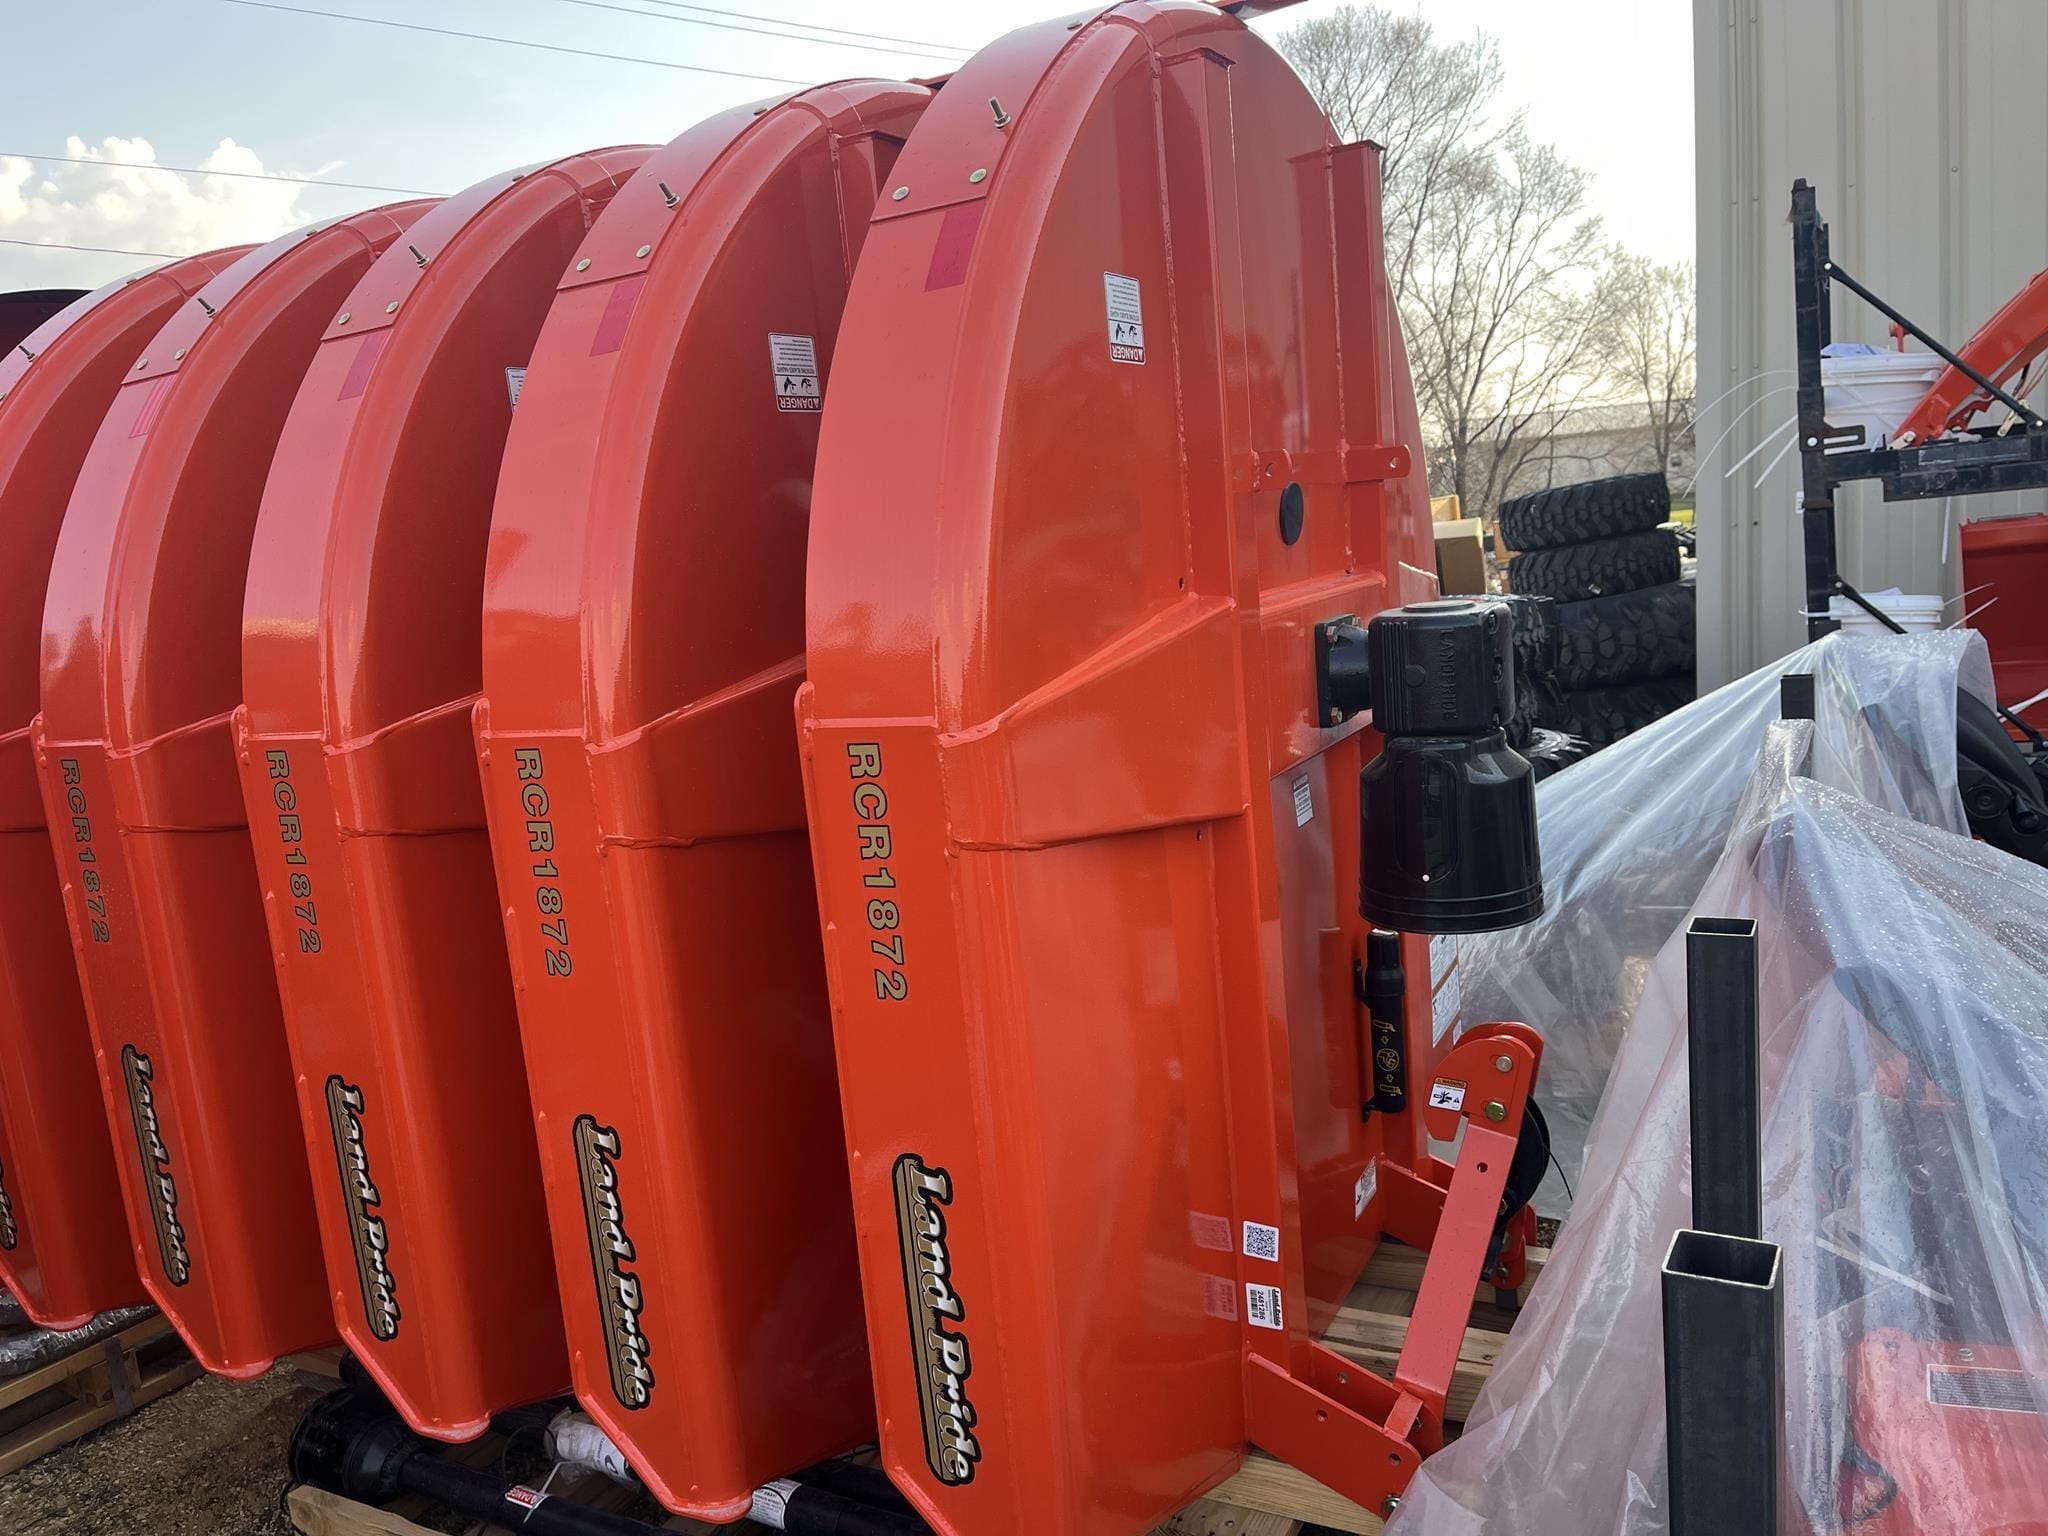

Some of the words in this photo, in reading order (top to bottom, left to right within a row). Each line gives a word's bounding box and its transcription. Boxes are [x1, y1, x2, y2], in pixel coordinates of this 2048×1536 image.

[779, 397, 813, 409] DANGER
[1112, 345, 1139, 360] DANGER
[61, 758, 110, 943] RCR1872
[266, 749, 322, 954] RCR1872
[515, 746, 574, 977] RCR1872
[847, 741, 908, 1001] RCR1872
[129, 1053, 169, 1163] Land
[154, 1173, 190, 1284] Pride
[335, 1083, 379, 1204] Land
[358, 1212, 399, 1338] Pride
[585, 1122, 635, 1262] Land
[909, 1161, 963, 1320] Land
[607, 1267, 654, 1406] Pride
[926, 1327, 978, 1482] Pride
